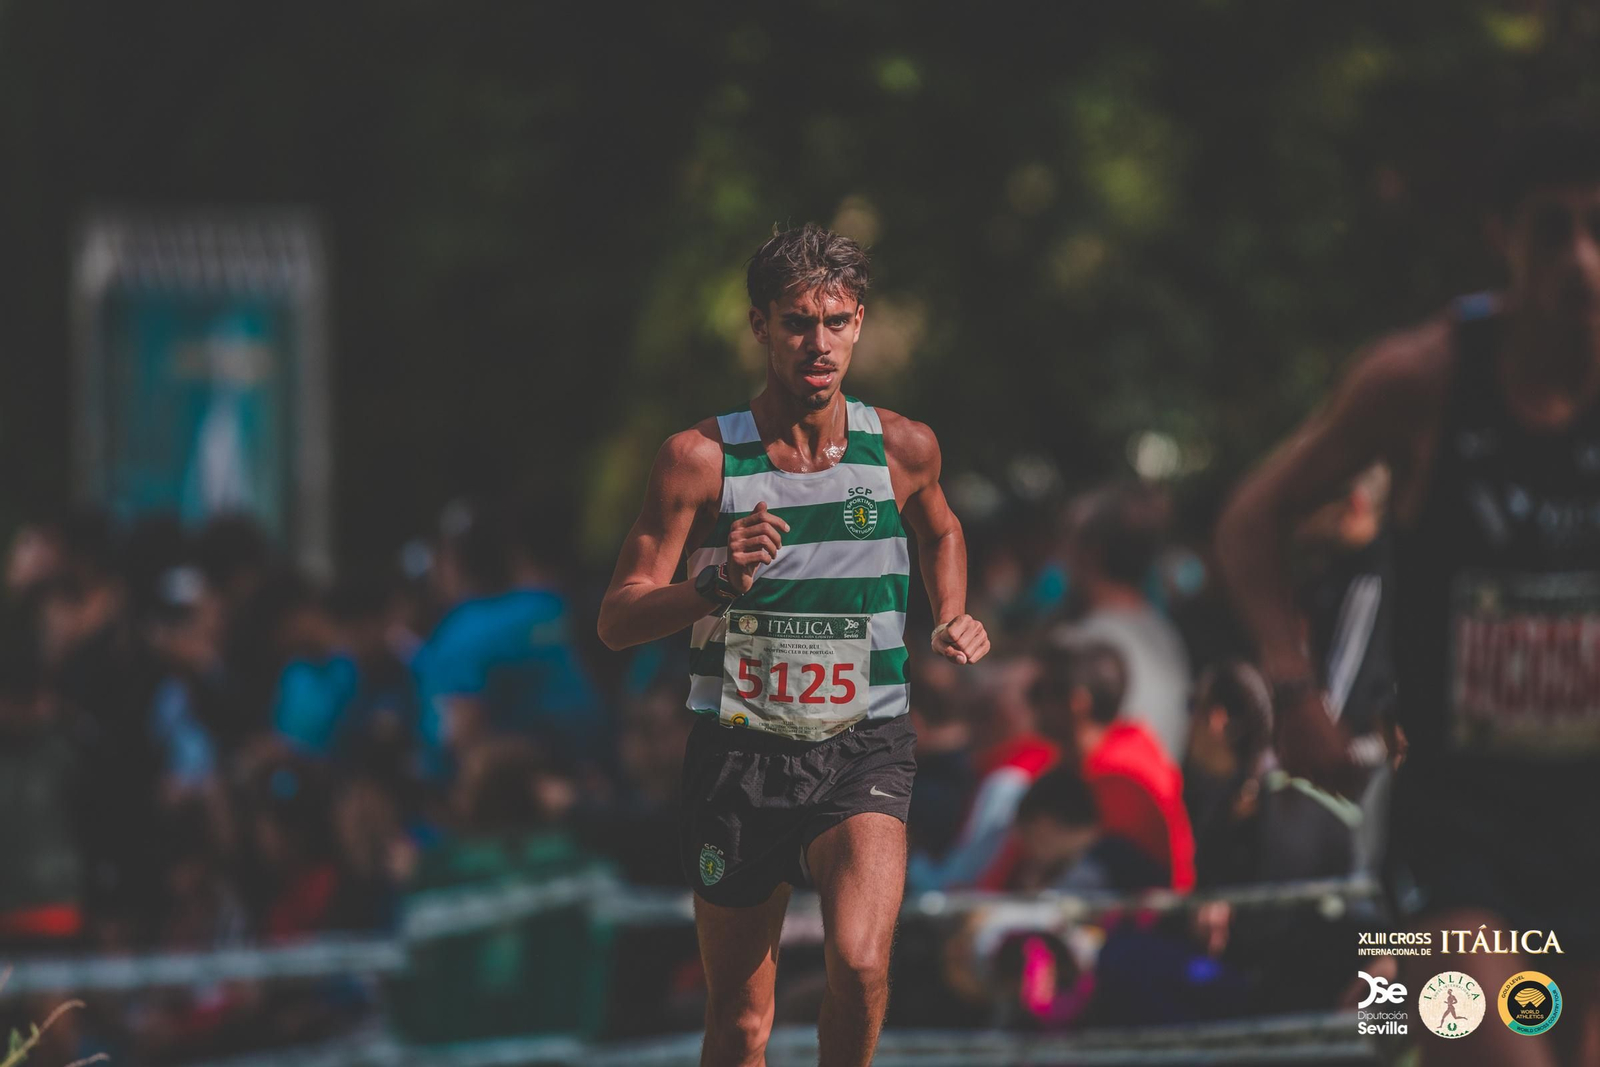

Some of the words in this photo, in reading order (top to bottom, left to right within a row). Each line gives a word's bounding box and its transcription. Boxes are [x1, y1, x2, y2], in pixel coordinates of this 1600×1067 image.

[848, 486, 873, 497] SCP
[847, 497, 874, 509] SPORTING
[768, 617, 834, 635] ITÁLICA
[736, 657, 857, 705] 5125
[704, 843, 724, 855] SCP
